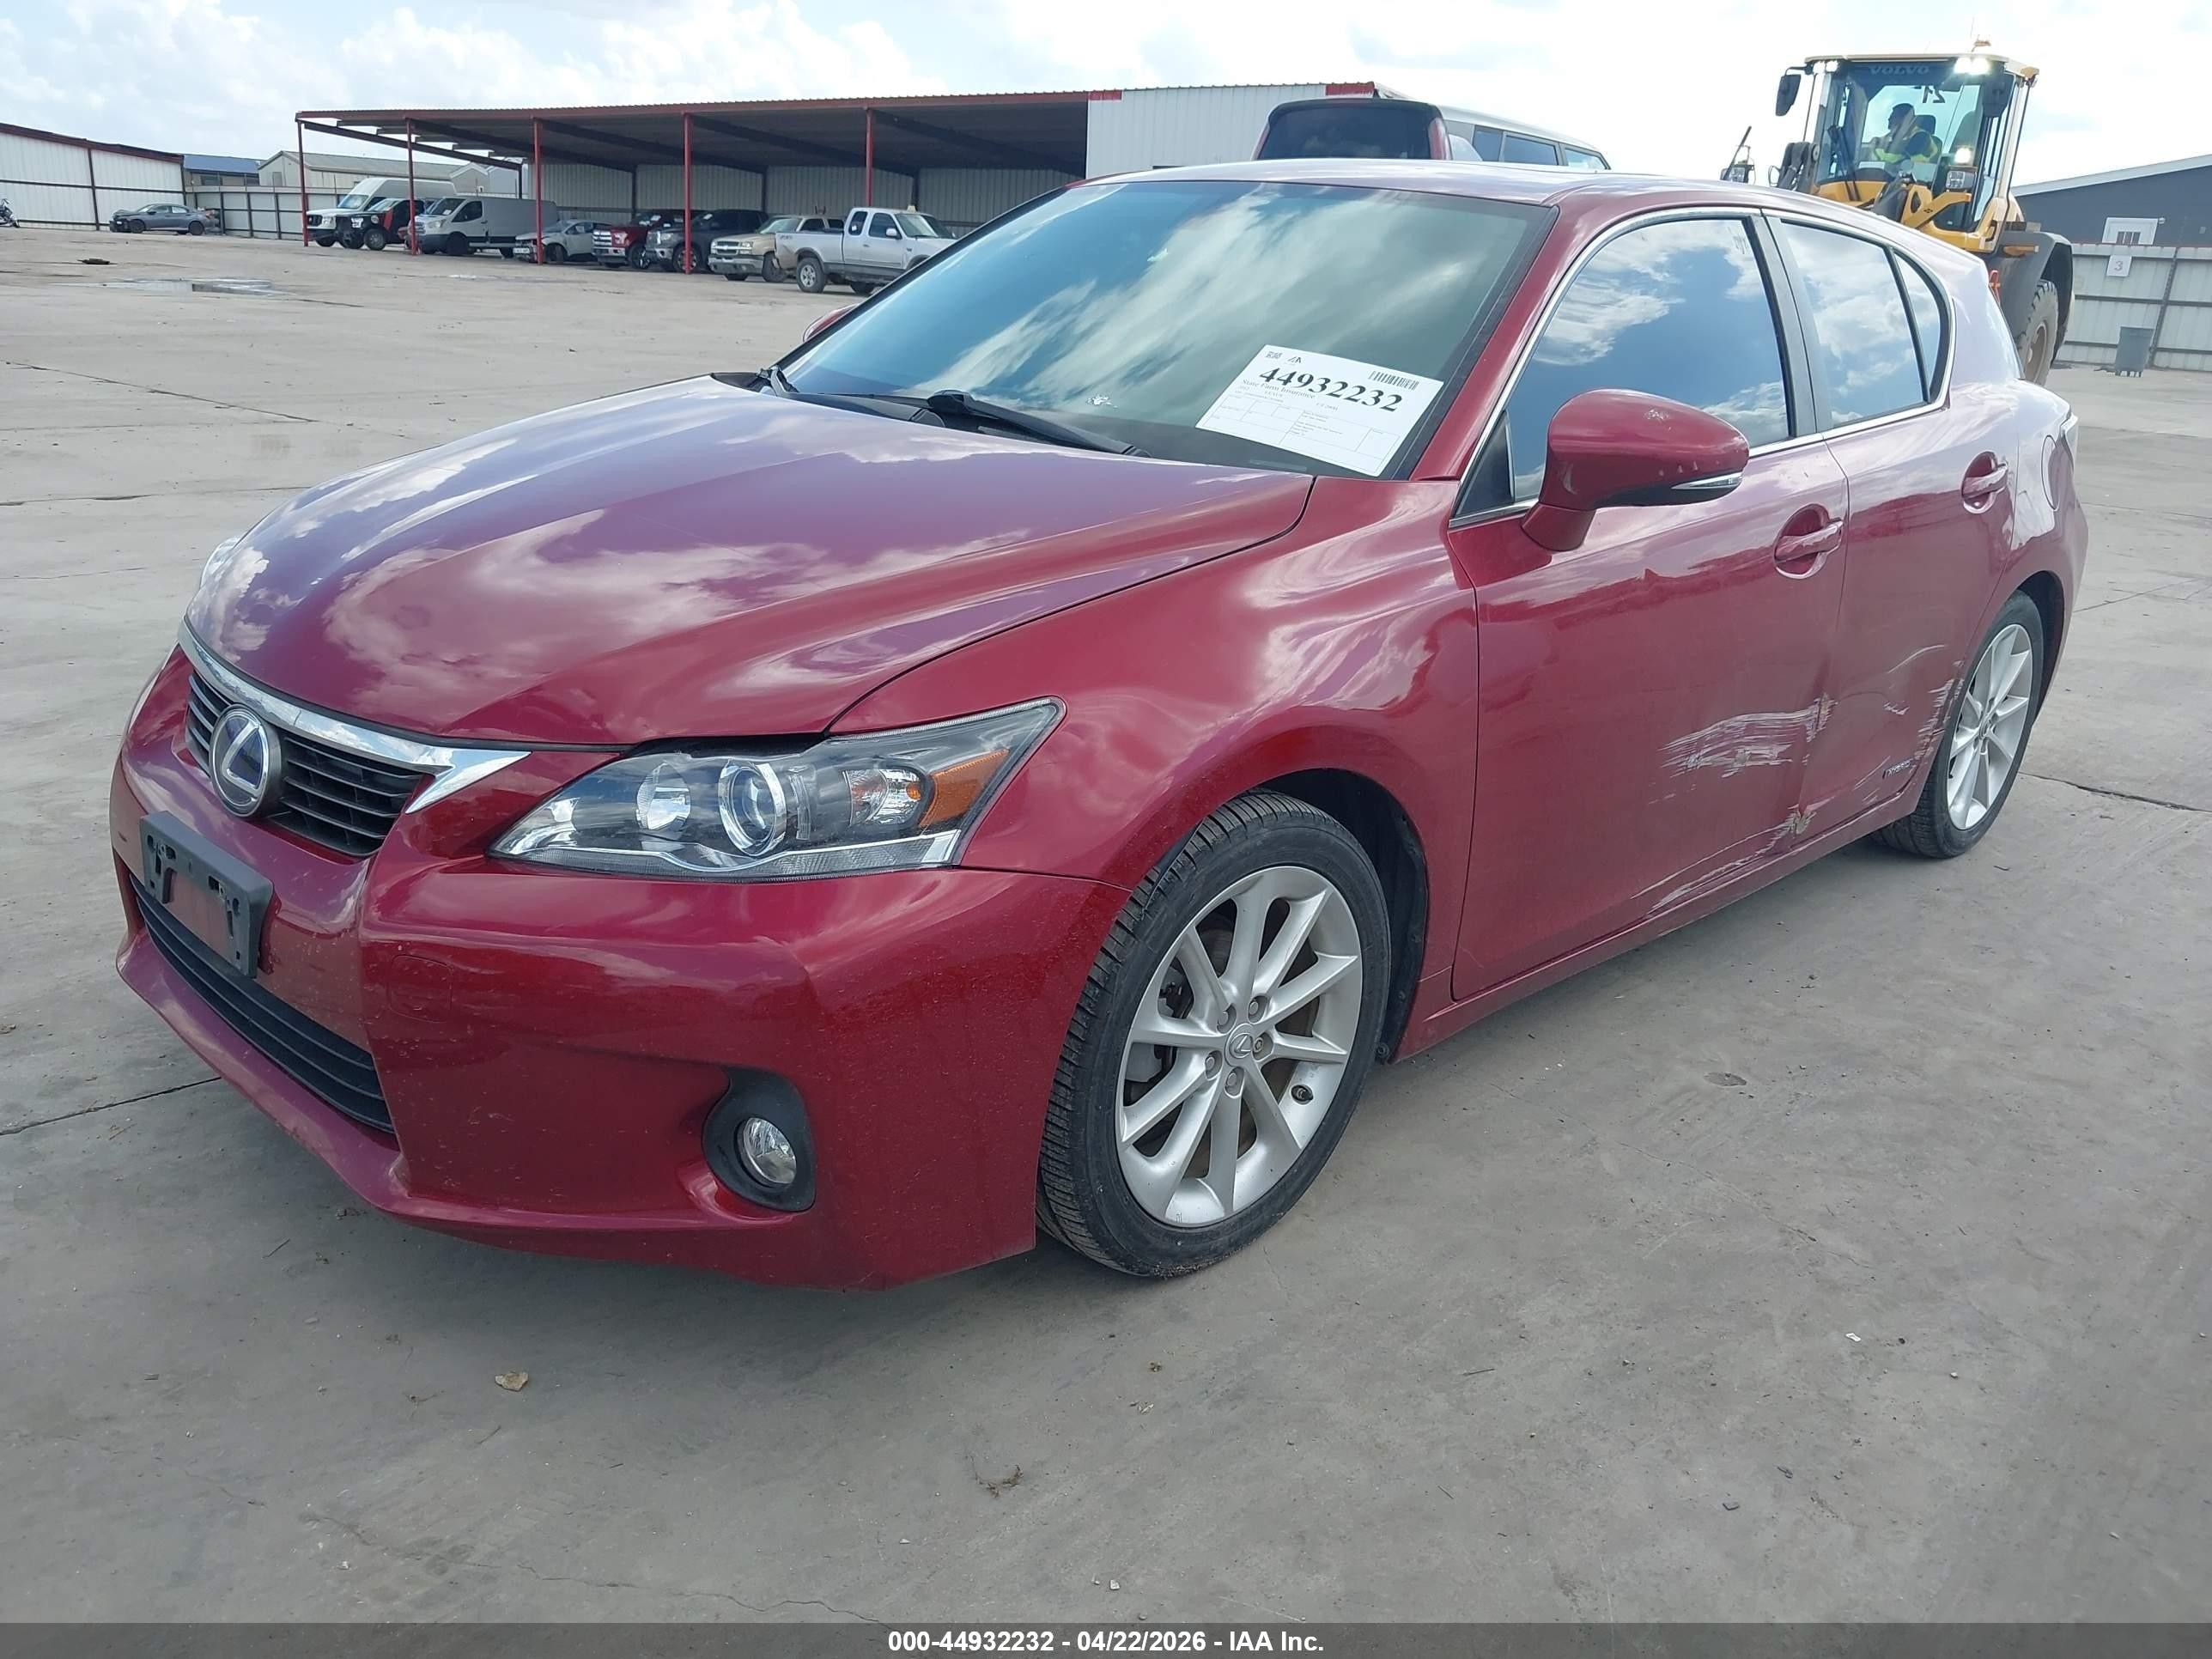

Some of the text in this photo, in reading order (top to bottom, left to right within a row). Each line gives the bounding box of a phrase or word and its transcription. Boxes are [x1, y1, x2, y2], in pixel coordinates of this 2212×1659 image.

[1869, 64, 1929, 76] VOLVO
[2114, 260, 2123, 271] 3
[1243, 380, 1261, 388] State
[1279, 386, 1316, 399] Insurance
[1259, 368, 1402, 412] 44932232
